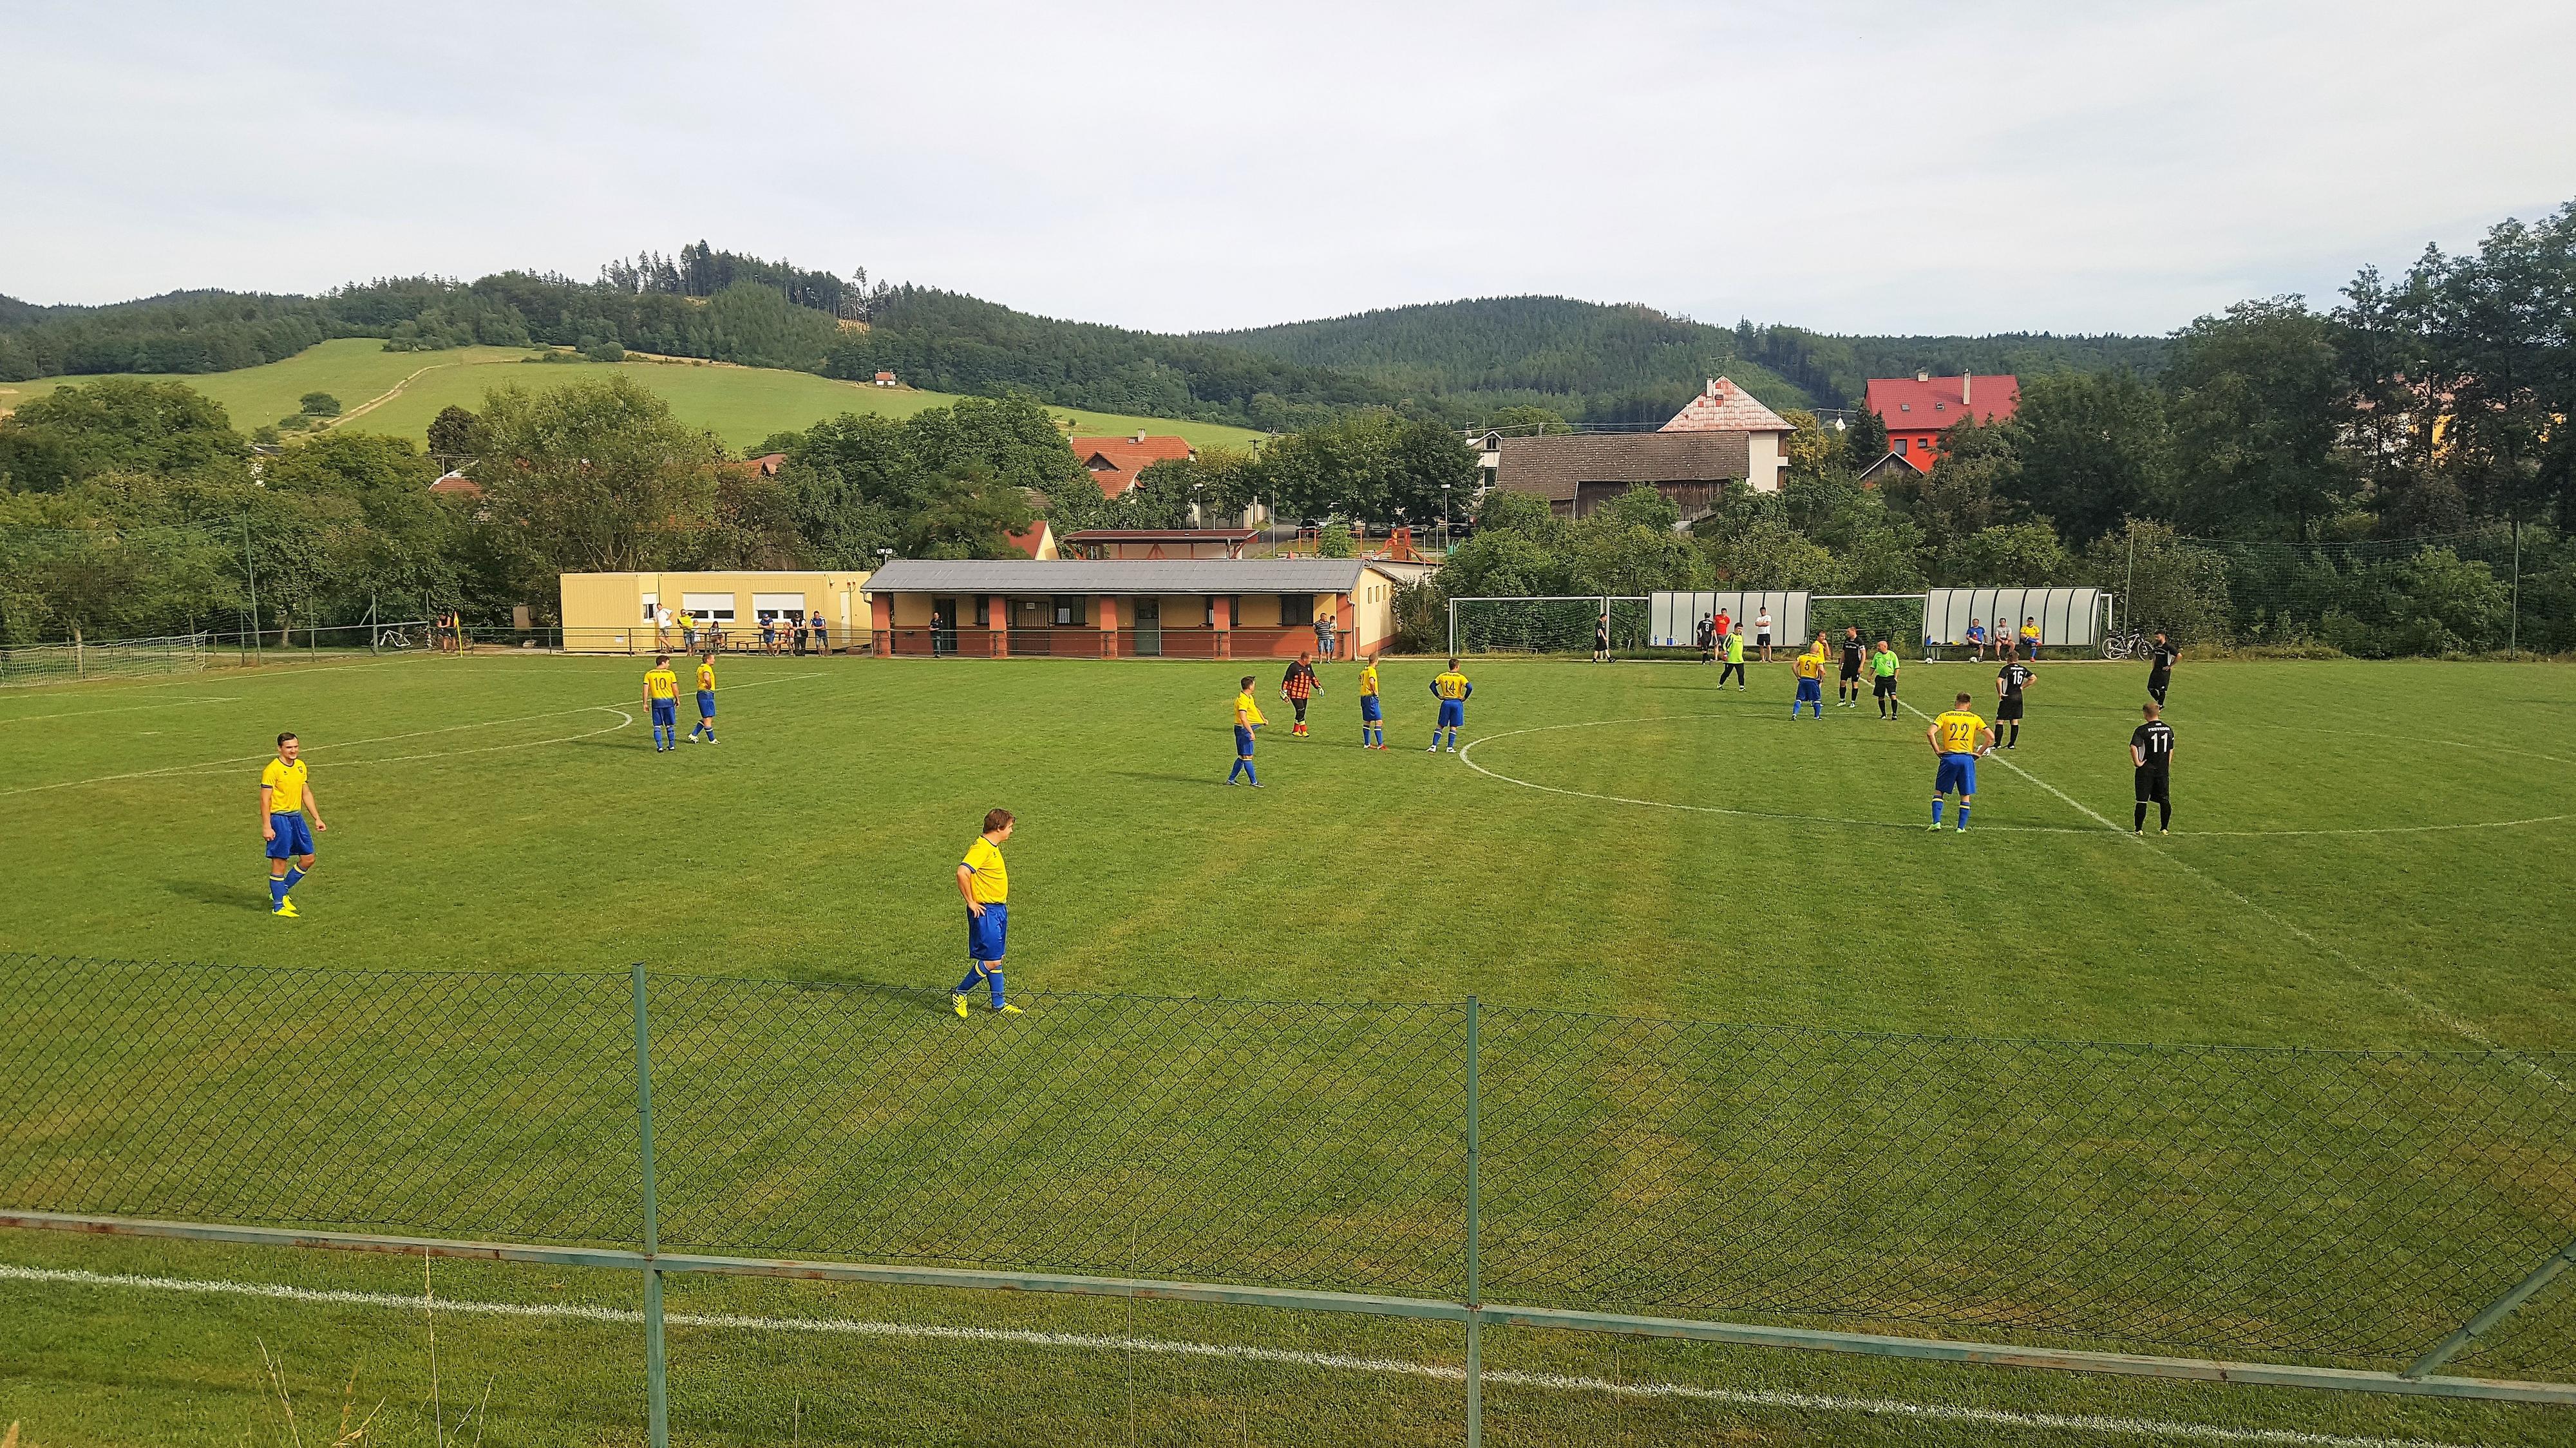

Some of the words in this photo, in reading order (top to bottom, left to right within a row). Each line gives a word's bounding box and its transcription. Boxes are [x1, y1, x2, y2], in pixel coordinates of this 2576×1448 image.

[1705, 623, 1709, 632] 8
[1805, 660, 1811, 671] 5
[654, 677, 667, 690] 10
[2013, 670, 2023, 684] 16
[1444, 680, 1456, 694] 14
[1949, 722, 1969, 741] 22
[2151, 733, 2168, 753] 11
